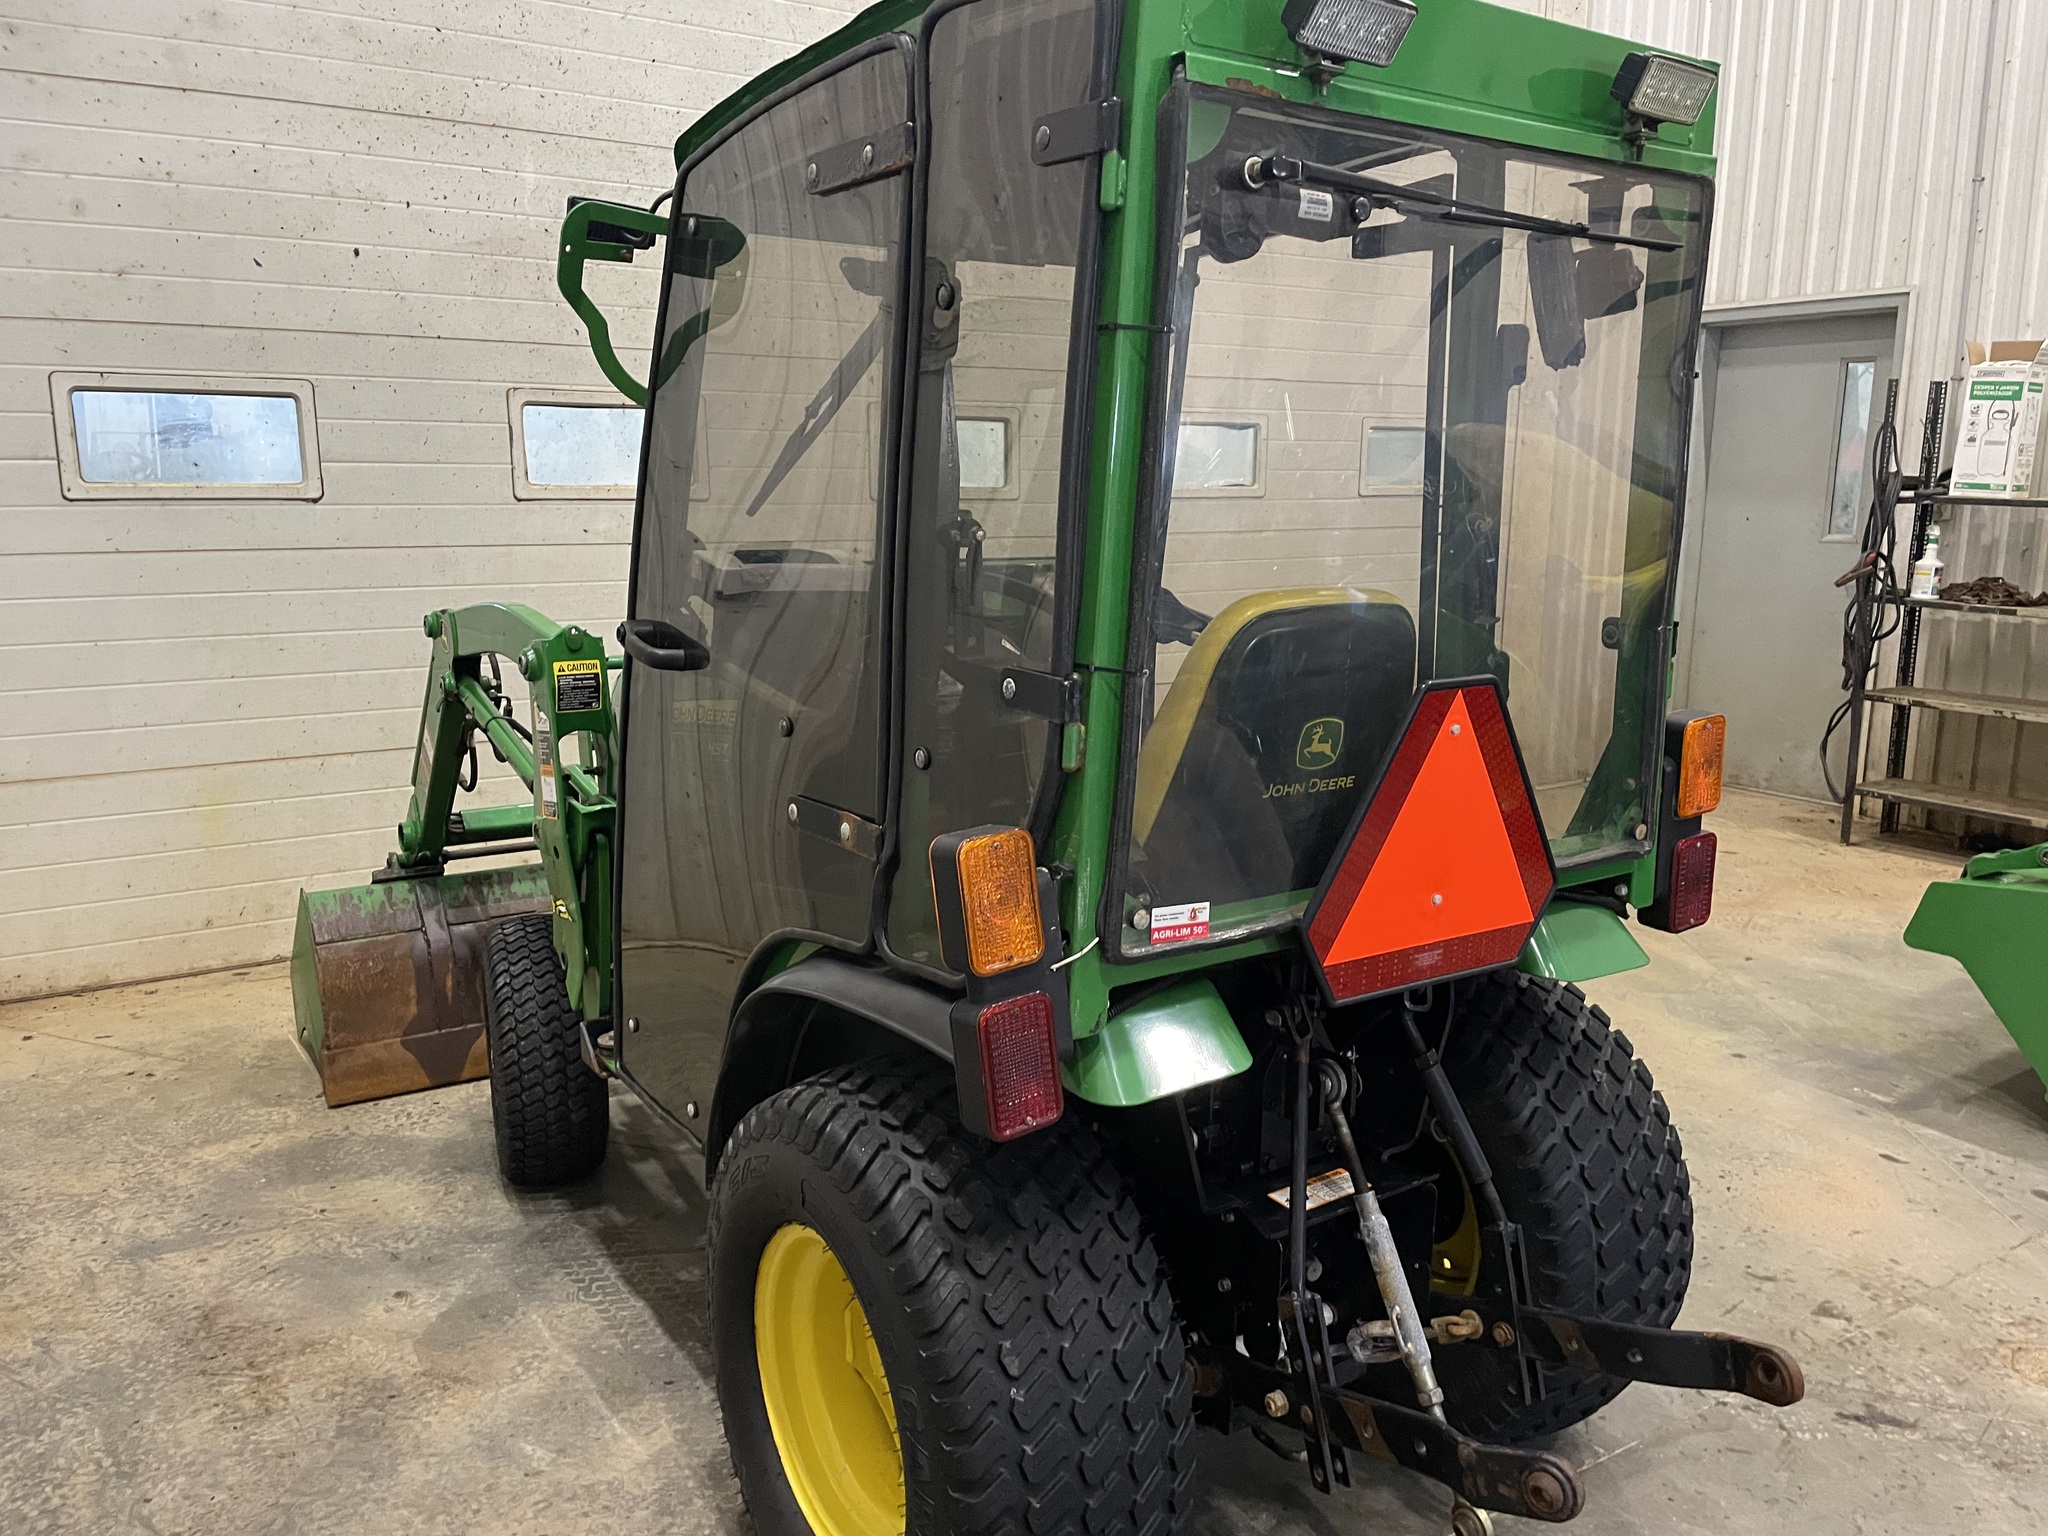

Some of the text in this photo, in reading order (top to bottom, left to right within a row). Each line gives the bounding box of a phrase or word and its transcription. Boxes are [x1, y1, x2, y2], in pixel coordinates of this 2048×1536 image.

[567, 662, 598, 672] CAUTION
[1262, 776, 1355, 798] JOHN DEERE
[1152, 926, 1191, 940] AGRI-LIM
